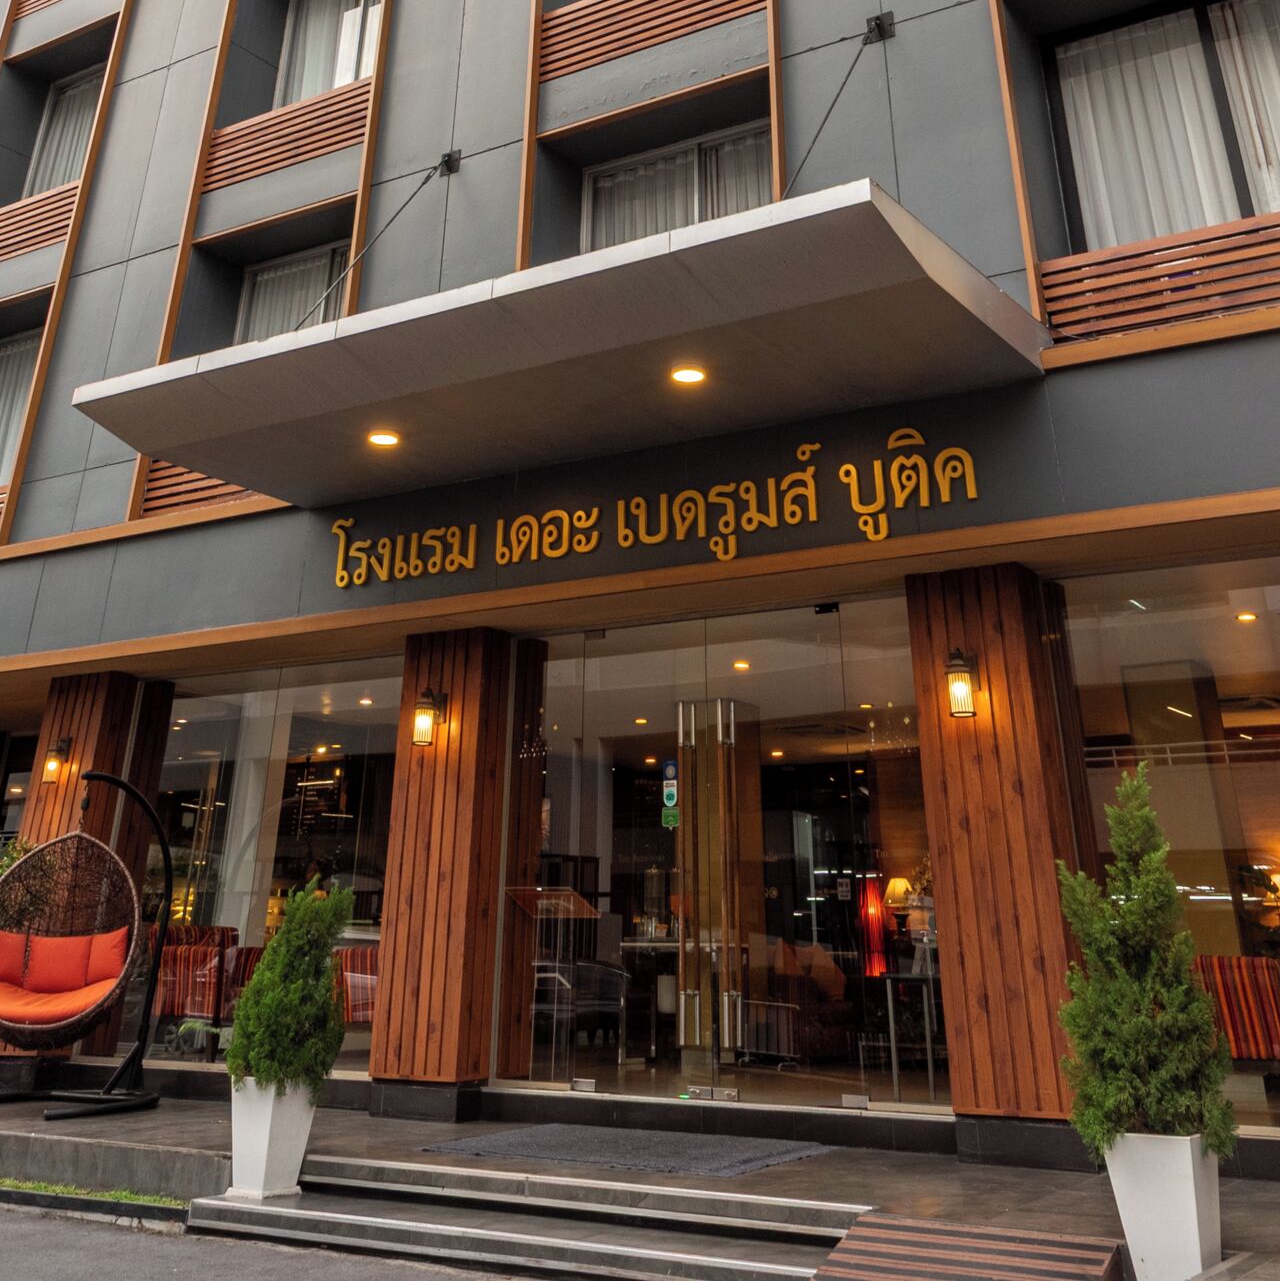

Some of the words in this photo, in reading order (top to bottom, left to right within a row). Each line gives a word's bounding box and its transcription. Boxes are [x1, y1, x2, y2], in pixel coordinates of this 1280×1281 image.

[331, 518, 478, 590] โรงแรม
[495, 506, 600, 565] เดอะ
[617, 443, 822, 562] เบดรูมส์
[839, 427, 979, 542] บูติค
